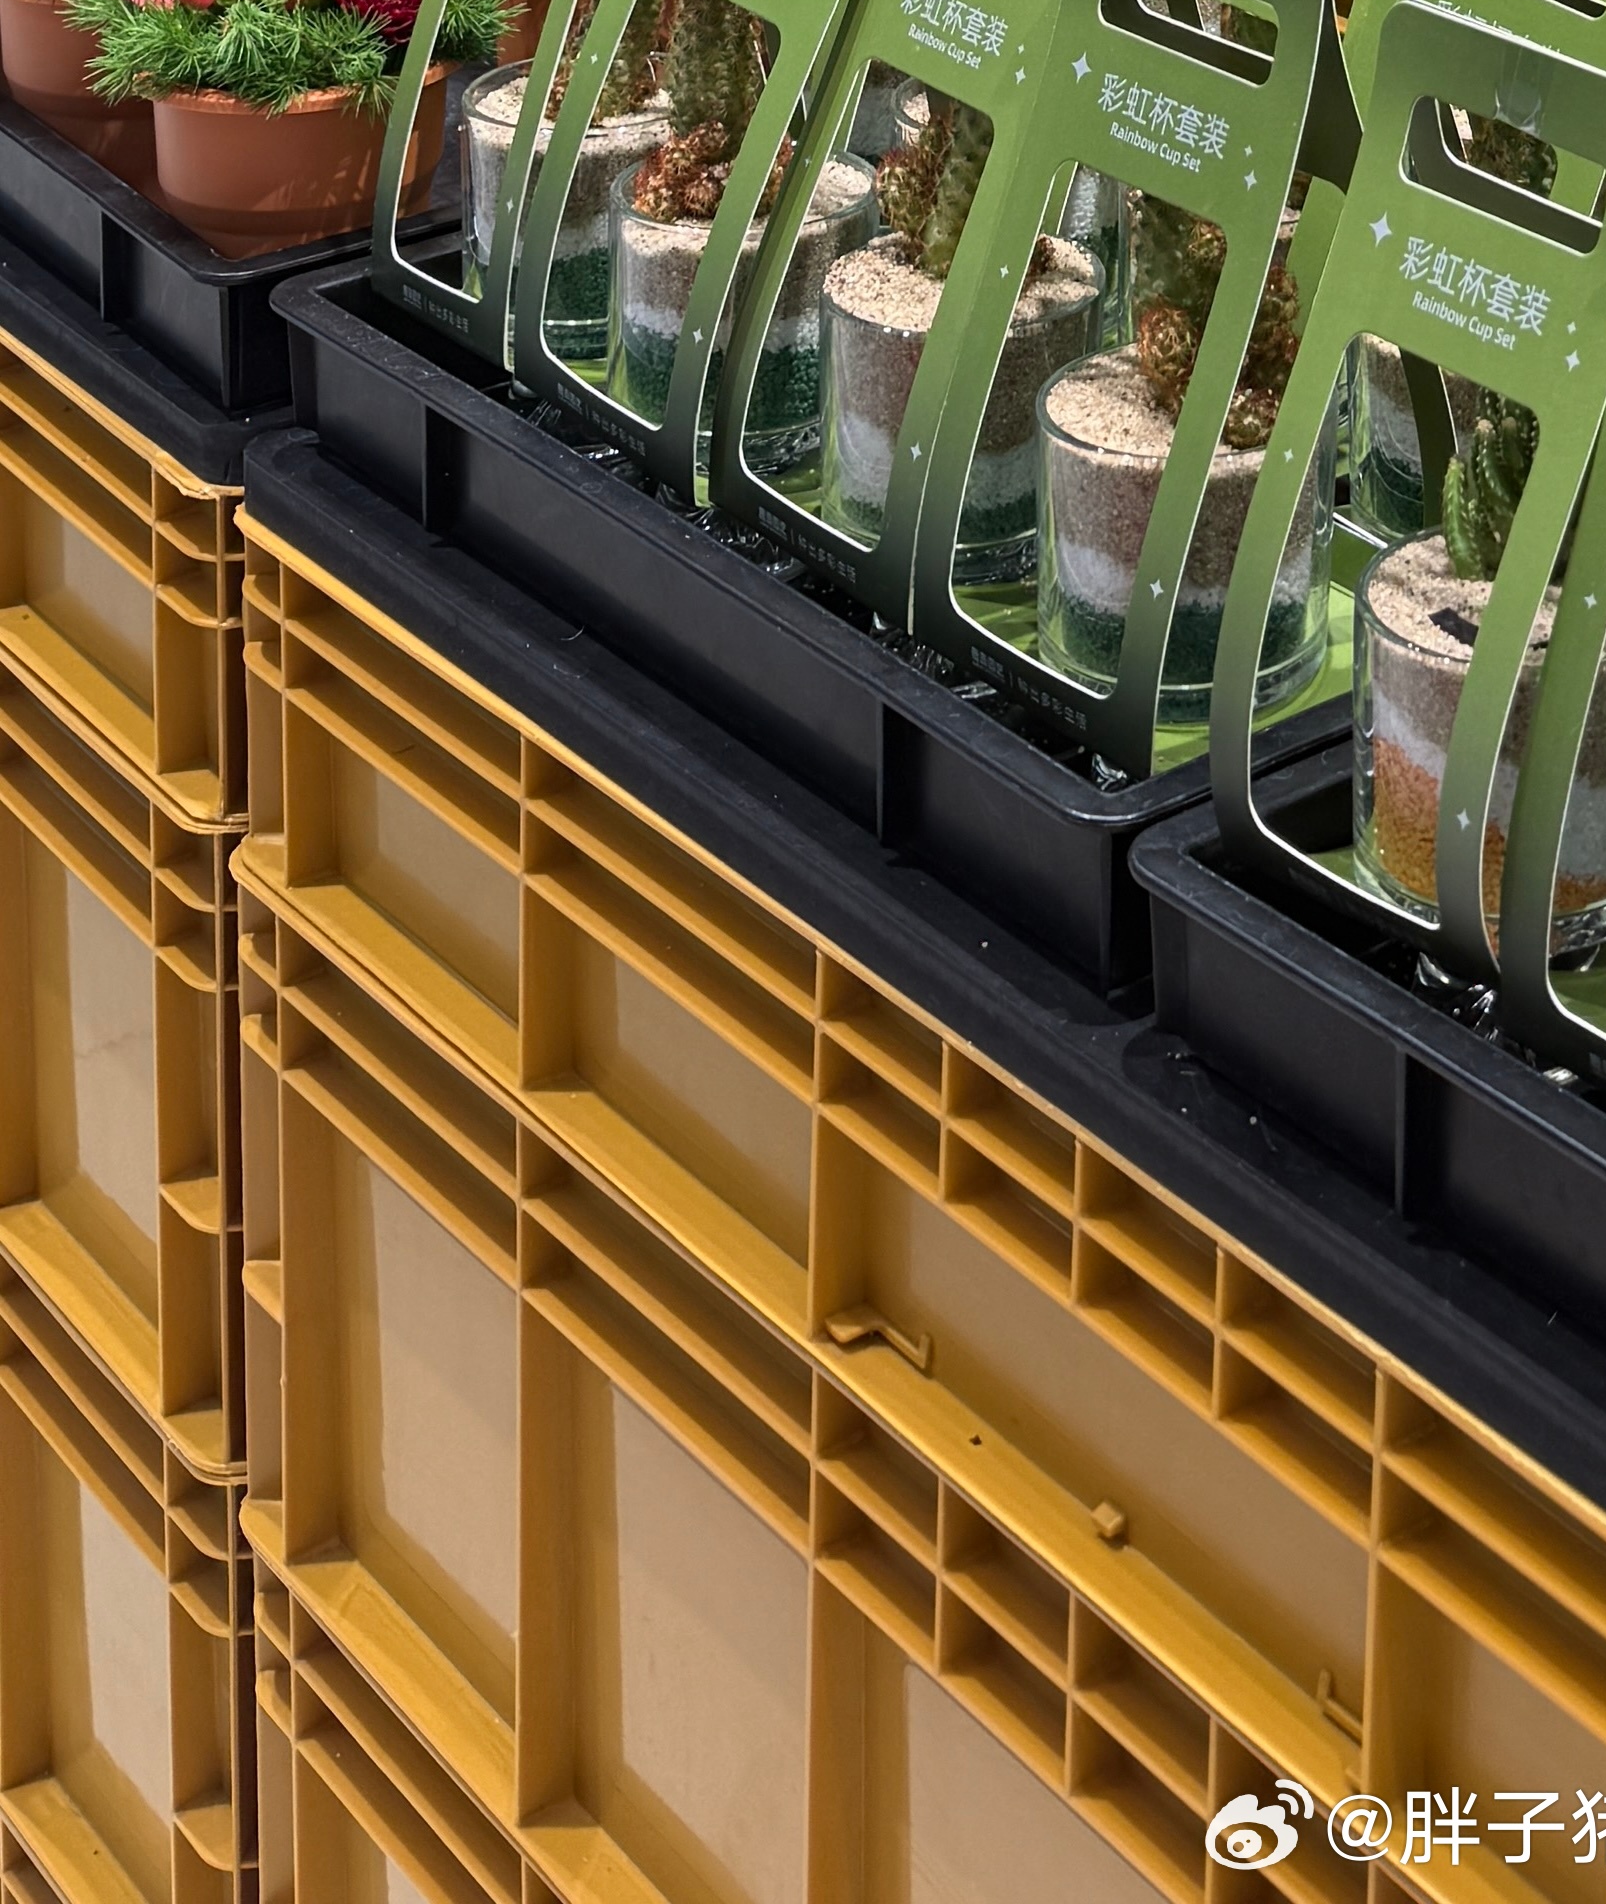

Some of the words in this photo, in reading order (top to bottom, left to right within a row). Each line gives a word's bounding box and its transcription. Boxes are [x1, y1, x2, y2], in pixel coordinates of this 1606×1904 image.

[908, 23, 948, 54] Rainbow
[948, 41, 965, 65] Cup
[965, 50, 982, 70] Set
[1098, 73, 1230, 160] 彩虹杯套装
[1110, 121, 1158, 155] Rainbow
[1160, 142, 1182, 167] Cup
[1182, 151, 1201, 174] Set
[1399, 236, 1552, 336] 彩虹杯套装
[1412, 291, 1466, 330] Rainbow
[1467, 315, 1492, 343] Cup
[1494, 327, 1516, 351] Set
